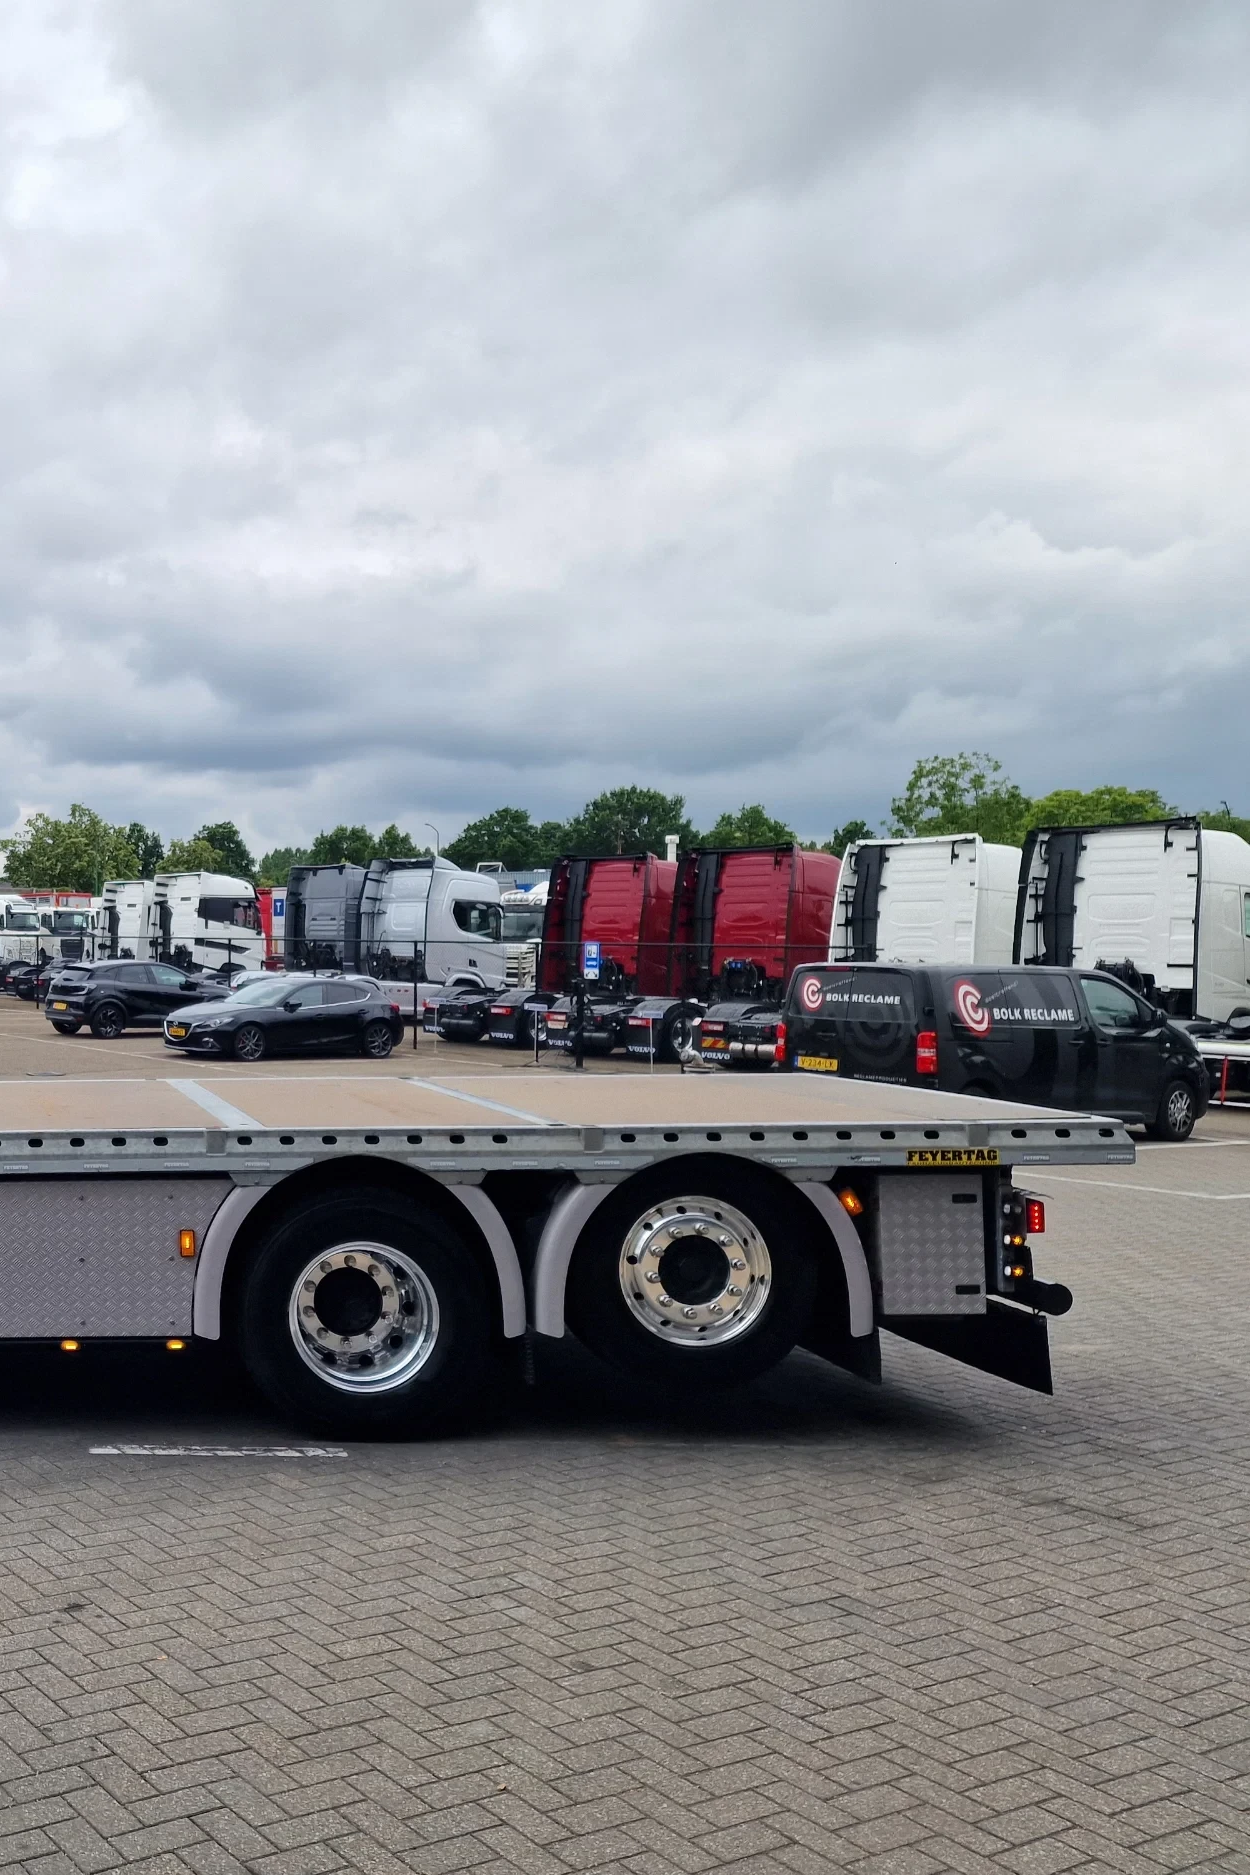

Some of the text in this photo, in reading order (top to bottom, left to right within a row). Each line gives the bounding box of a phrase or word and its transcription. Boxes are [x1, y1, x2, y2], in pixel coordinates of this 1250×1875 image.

[826, 992, 901, 1005] BOLK RECLAME
[993, 1008, 1075, 1022] BOLK RECLAME
[490, 1032, 514, 1040] VOLVO
[548, 1038, 573, 1047] VOLVO
[628, 1045, 656, 1053] VOLVO
[701, 1051, 731, 1060] VOLVO
[907, 1149, 998, 1161] FEYERTAG
